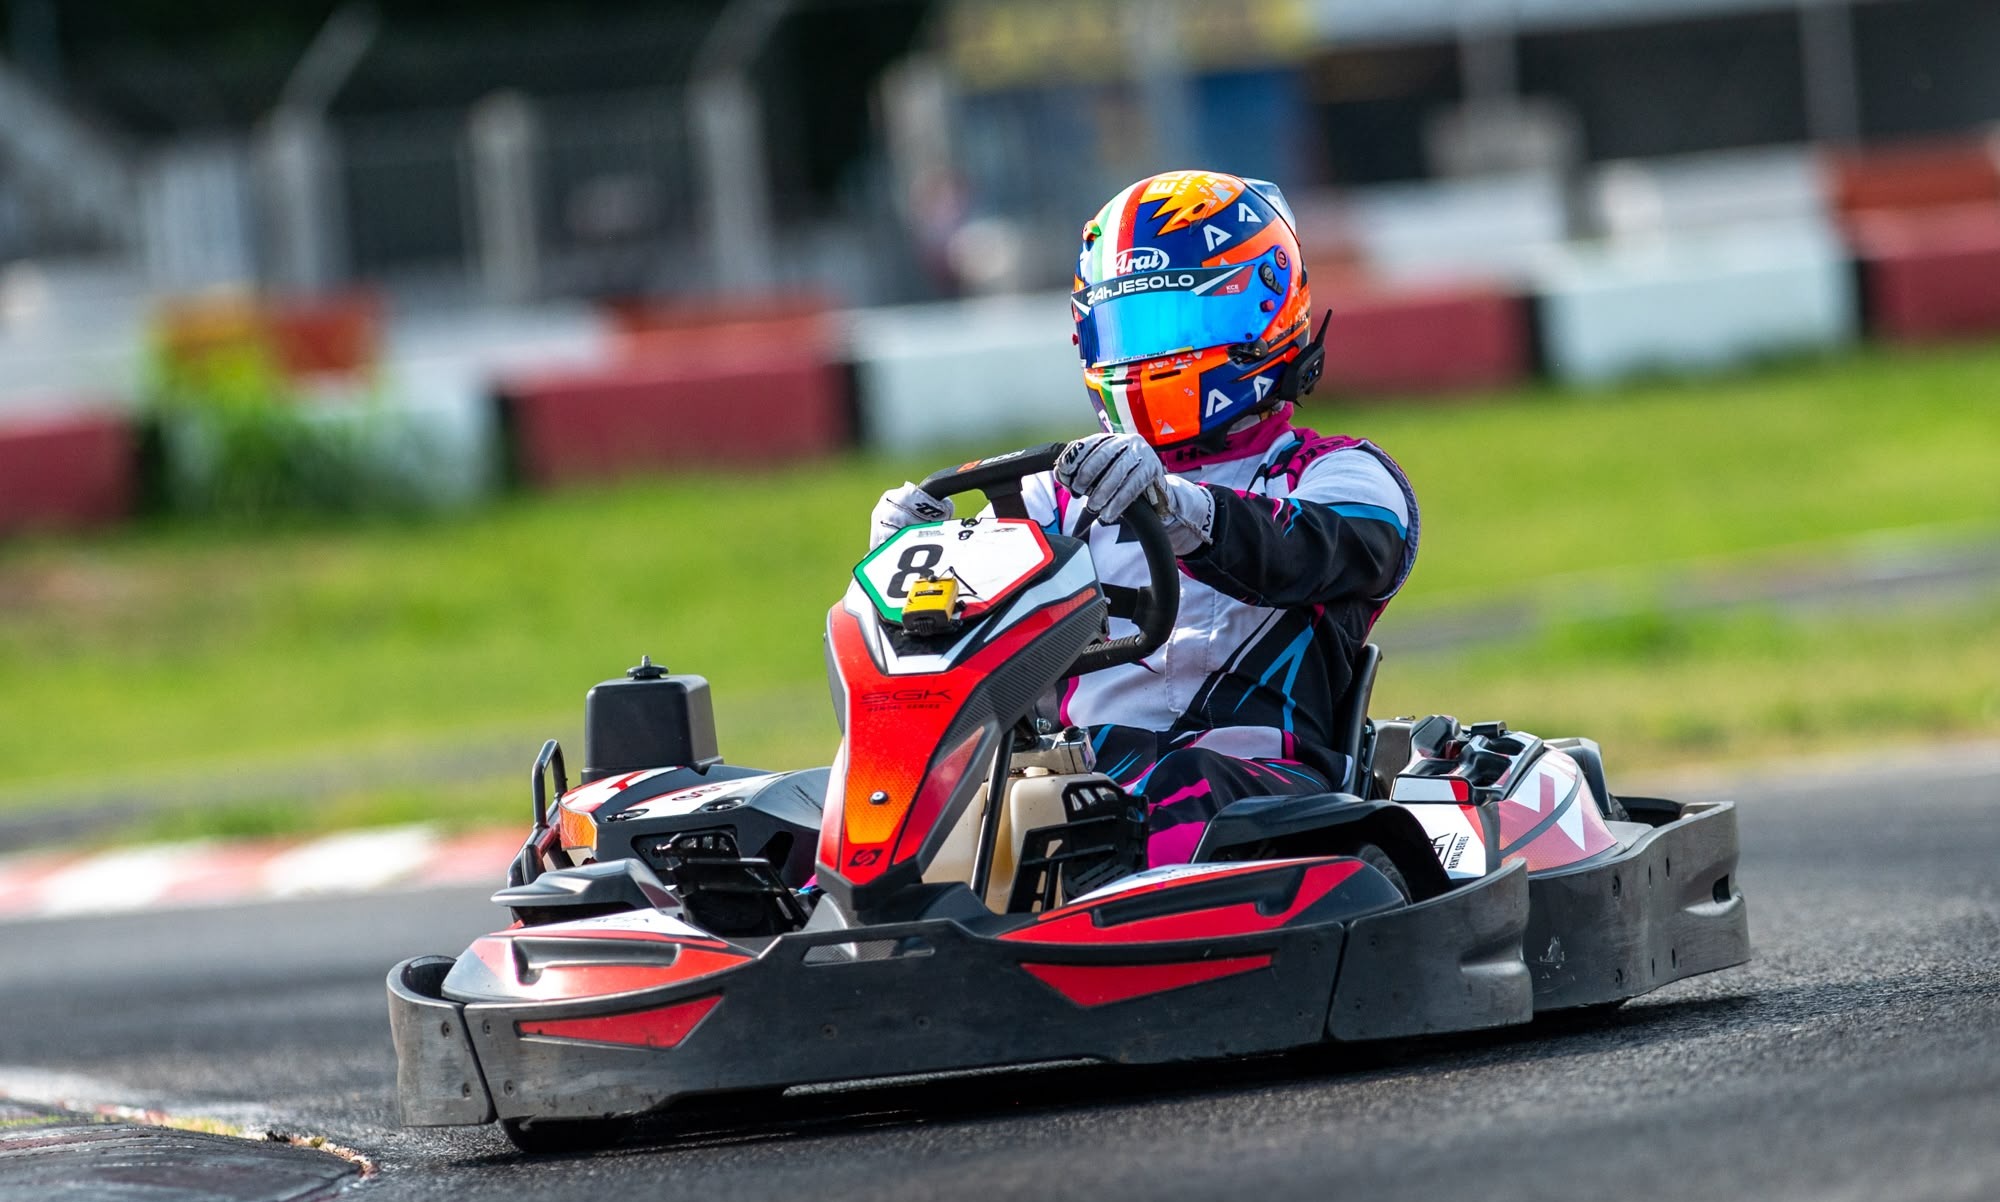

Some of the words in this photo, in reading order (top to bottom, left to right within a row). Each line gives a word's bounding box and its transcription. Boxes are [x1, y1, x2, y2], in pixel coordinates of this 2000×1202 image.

[1115, 250, 1161, 274] Arai
[958, 530, 975, 541] 8
[886, 544, 944, 598] 8
[860, 689, 953, 705] SGK
[1455, 835, 1470, 851] SERIES
[1447, 850, 1464, 869] RENTAL
